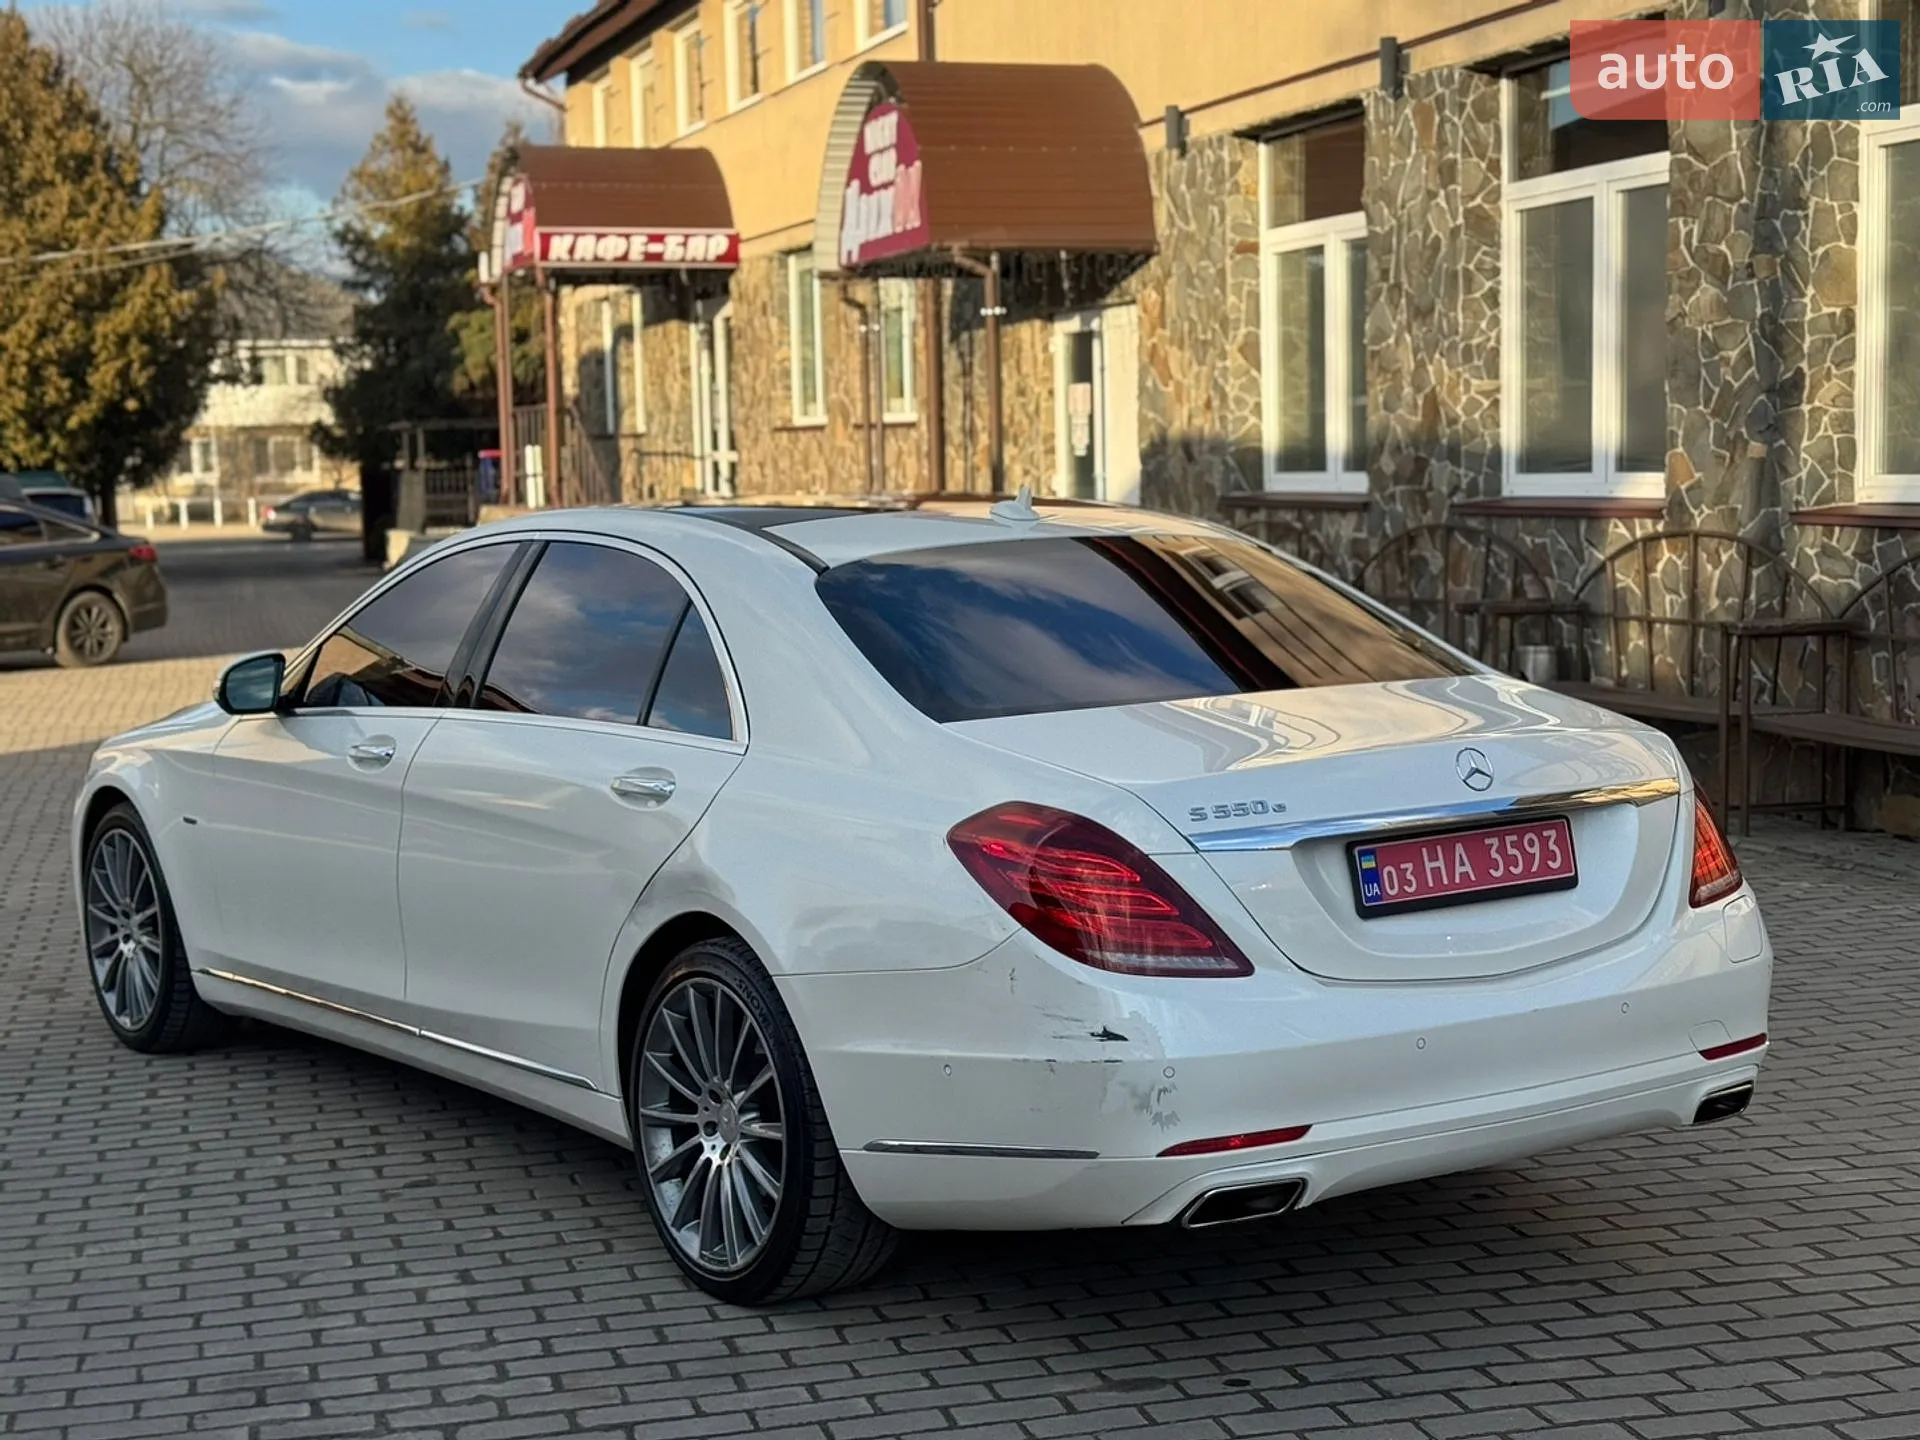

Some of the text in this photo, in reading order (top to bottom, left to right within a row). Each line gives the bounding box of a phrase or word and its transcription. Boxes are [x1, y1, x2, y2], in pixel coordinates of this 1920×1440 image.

[548, 234, 729, 262] КАФЕ-БАР
[1484, 829, 1563, 878] 3593
[1364, 882, 1381, 897] UA
